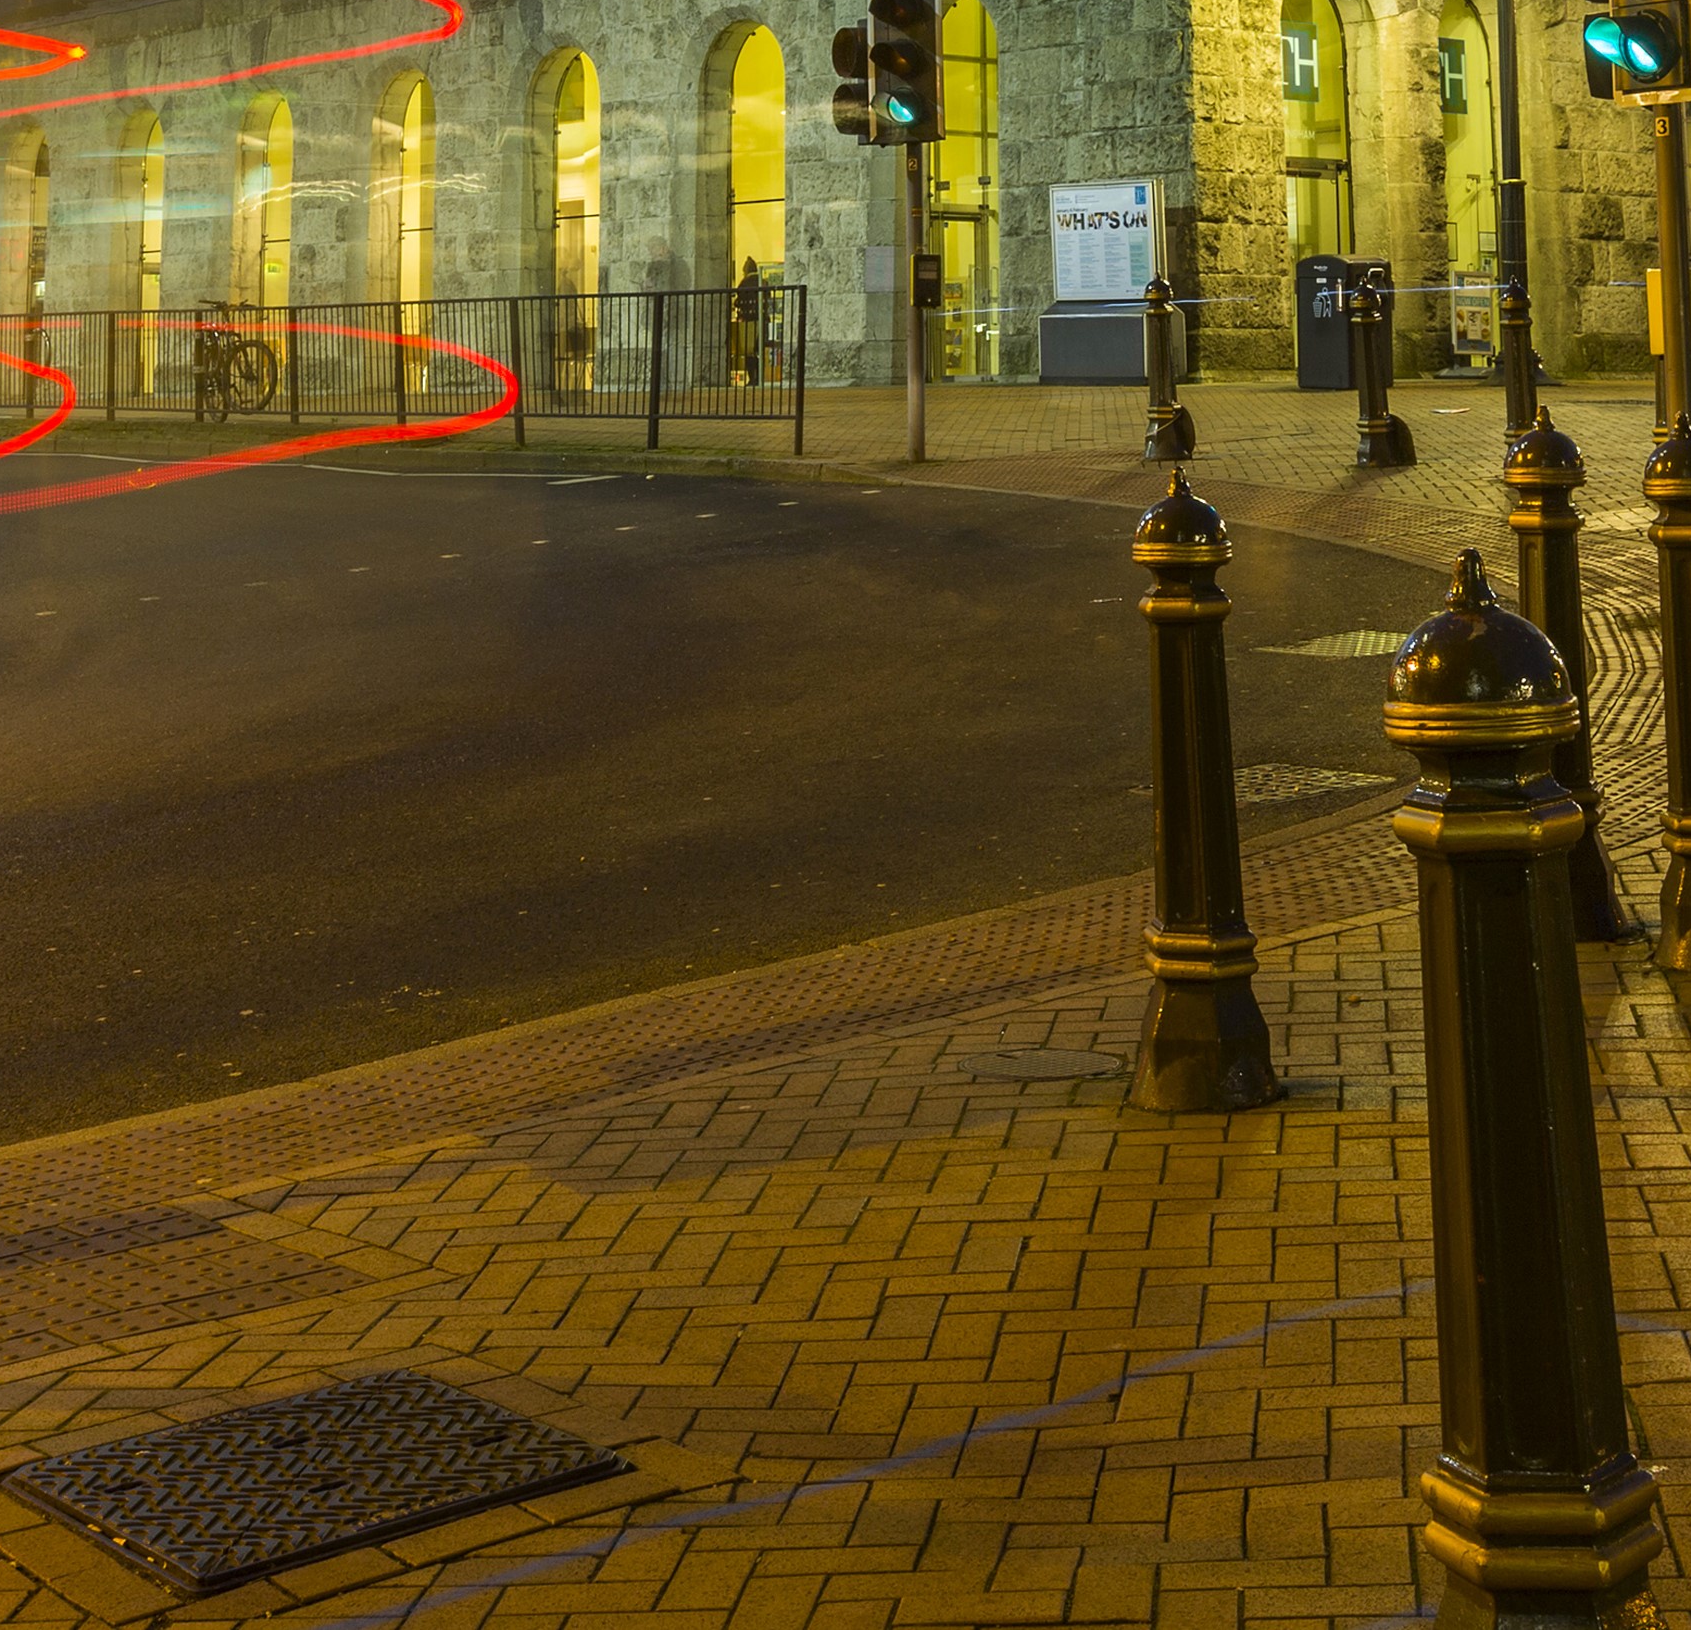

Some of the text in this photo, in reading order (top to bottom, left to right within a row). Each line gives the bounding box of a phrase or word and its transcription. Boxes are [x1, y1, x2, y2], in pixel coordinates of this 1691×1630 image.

[1657, 118, 1667, 135] 3
[908, 159, 917, 170] 2
[1057, 210, 1148, 230] WHAT'S ON
